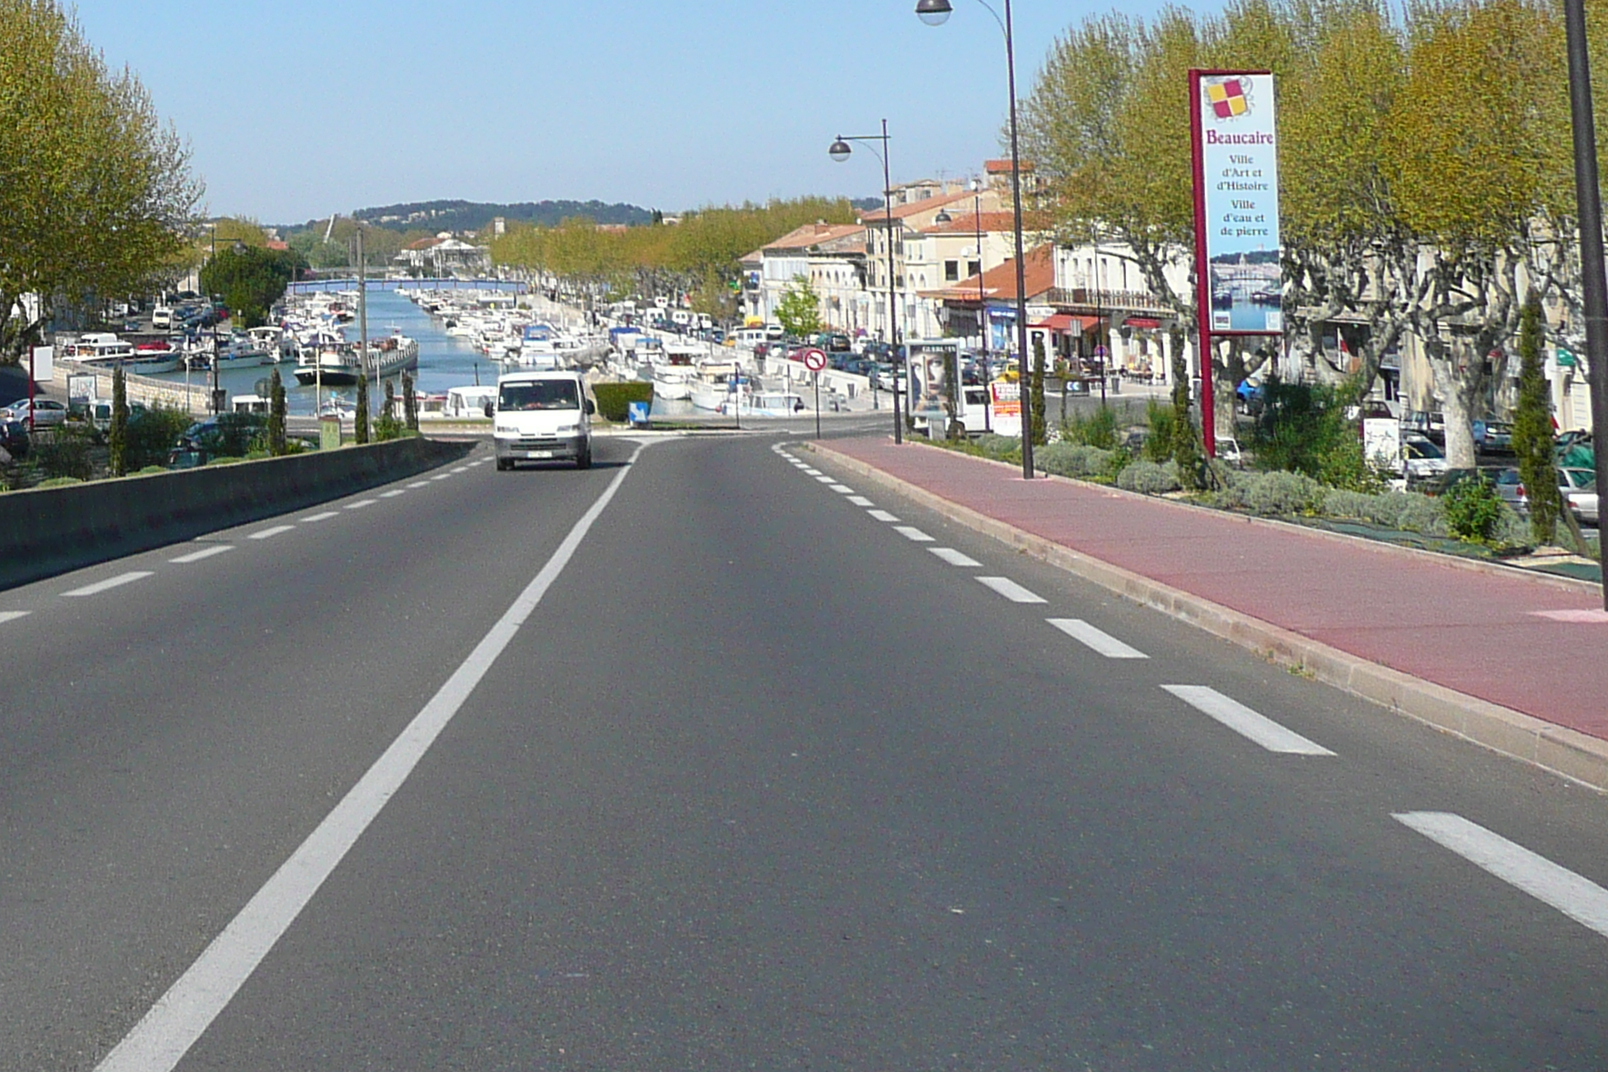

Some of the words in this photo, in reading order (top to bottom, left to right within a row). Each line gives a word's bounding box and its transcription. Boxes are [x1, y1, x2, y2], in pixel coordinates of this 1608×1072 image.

[1206, 129, 1274, 145] Beaucaire
[1229, 155, 1254, 164] Ville
[1222, 168, 1249, 177] d'Art
[1252, 169, 1262, 177] et
[1216, 181, 1269, 190] d'Histoire
[1231, 199, 1256, 209] Ville
[1223, 213, 1252, 222] d'eau
[1254, 214, 1265, 222] et
[1220, 227, 1233, 236] de
[1236, 227, 1269, 238] pierre
